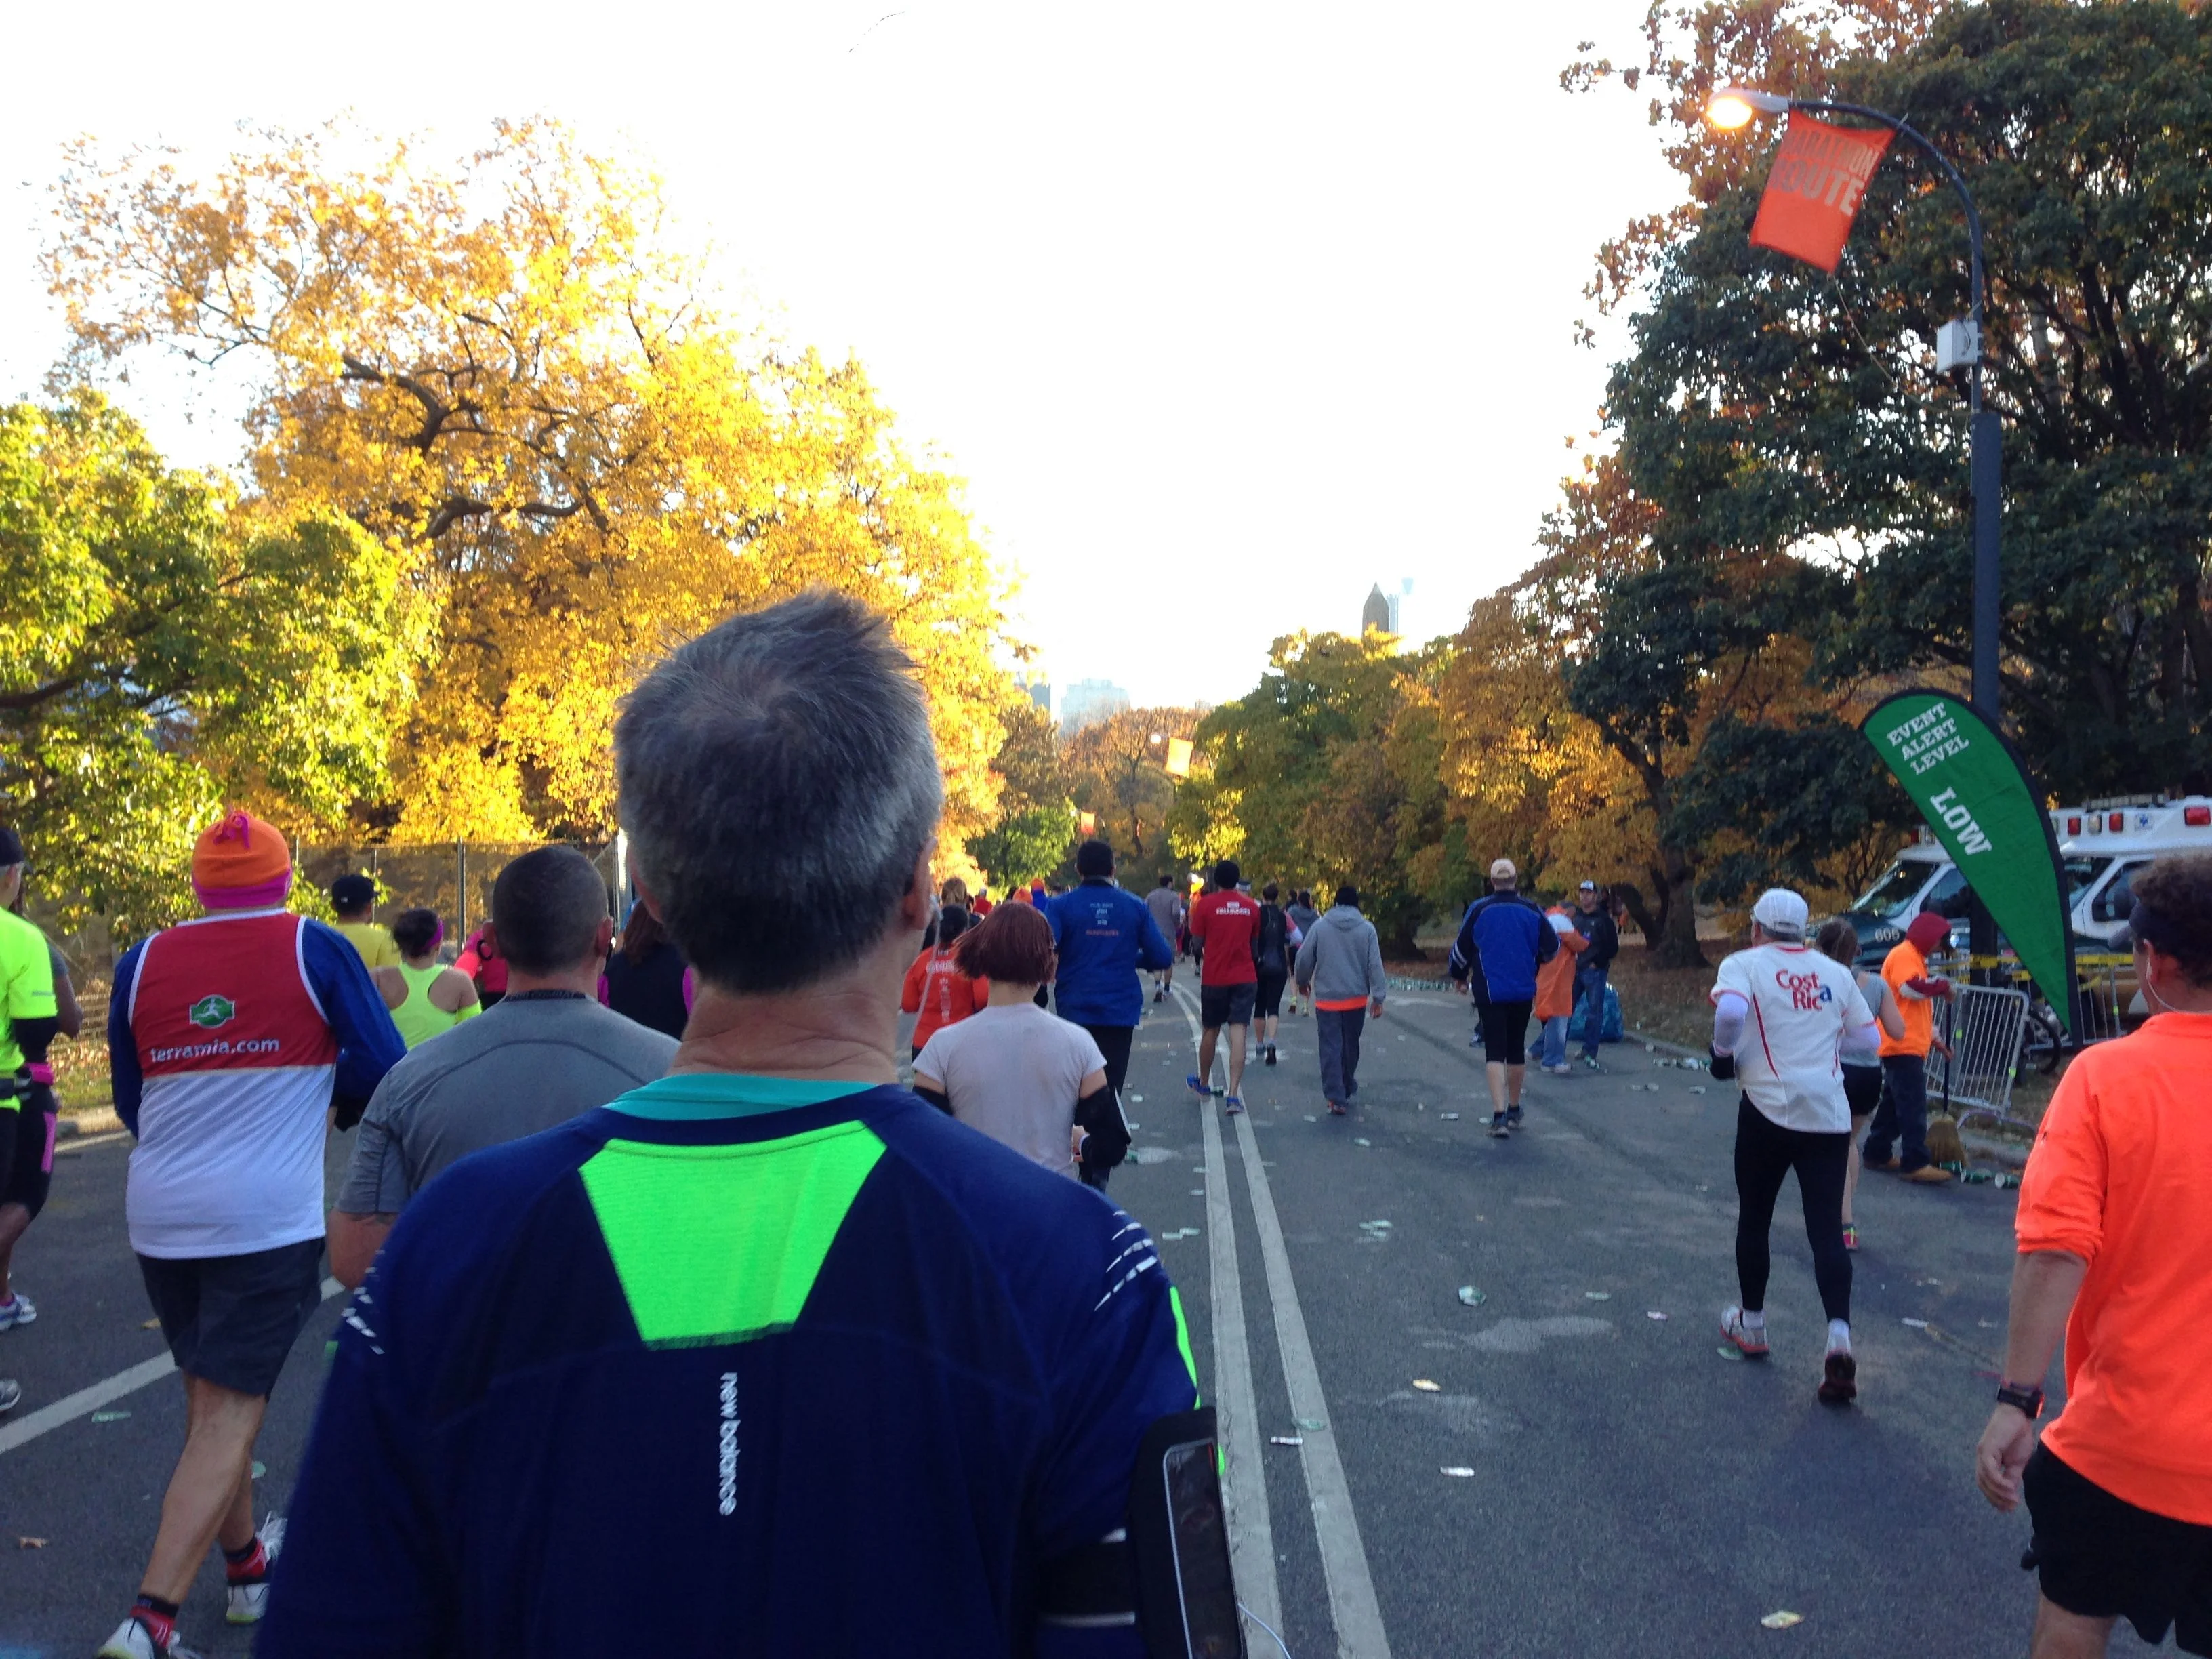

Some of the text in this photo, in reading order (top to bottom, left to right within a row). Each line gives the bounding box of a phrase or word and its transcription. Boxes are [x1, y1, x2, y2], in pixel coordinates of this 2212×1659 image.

[1887, 702, 1946, 746] EVENT
[1902, 717, 1957, 761] ALERT
[1910, 735, 1969, 775] LEVEL
[1930, 786, 1992, 855] LOW
[150, 1038, 279, 1063] terramia.com
[719, 1372, 741, 1516] new balance
